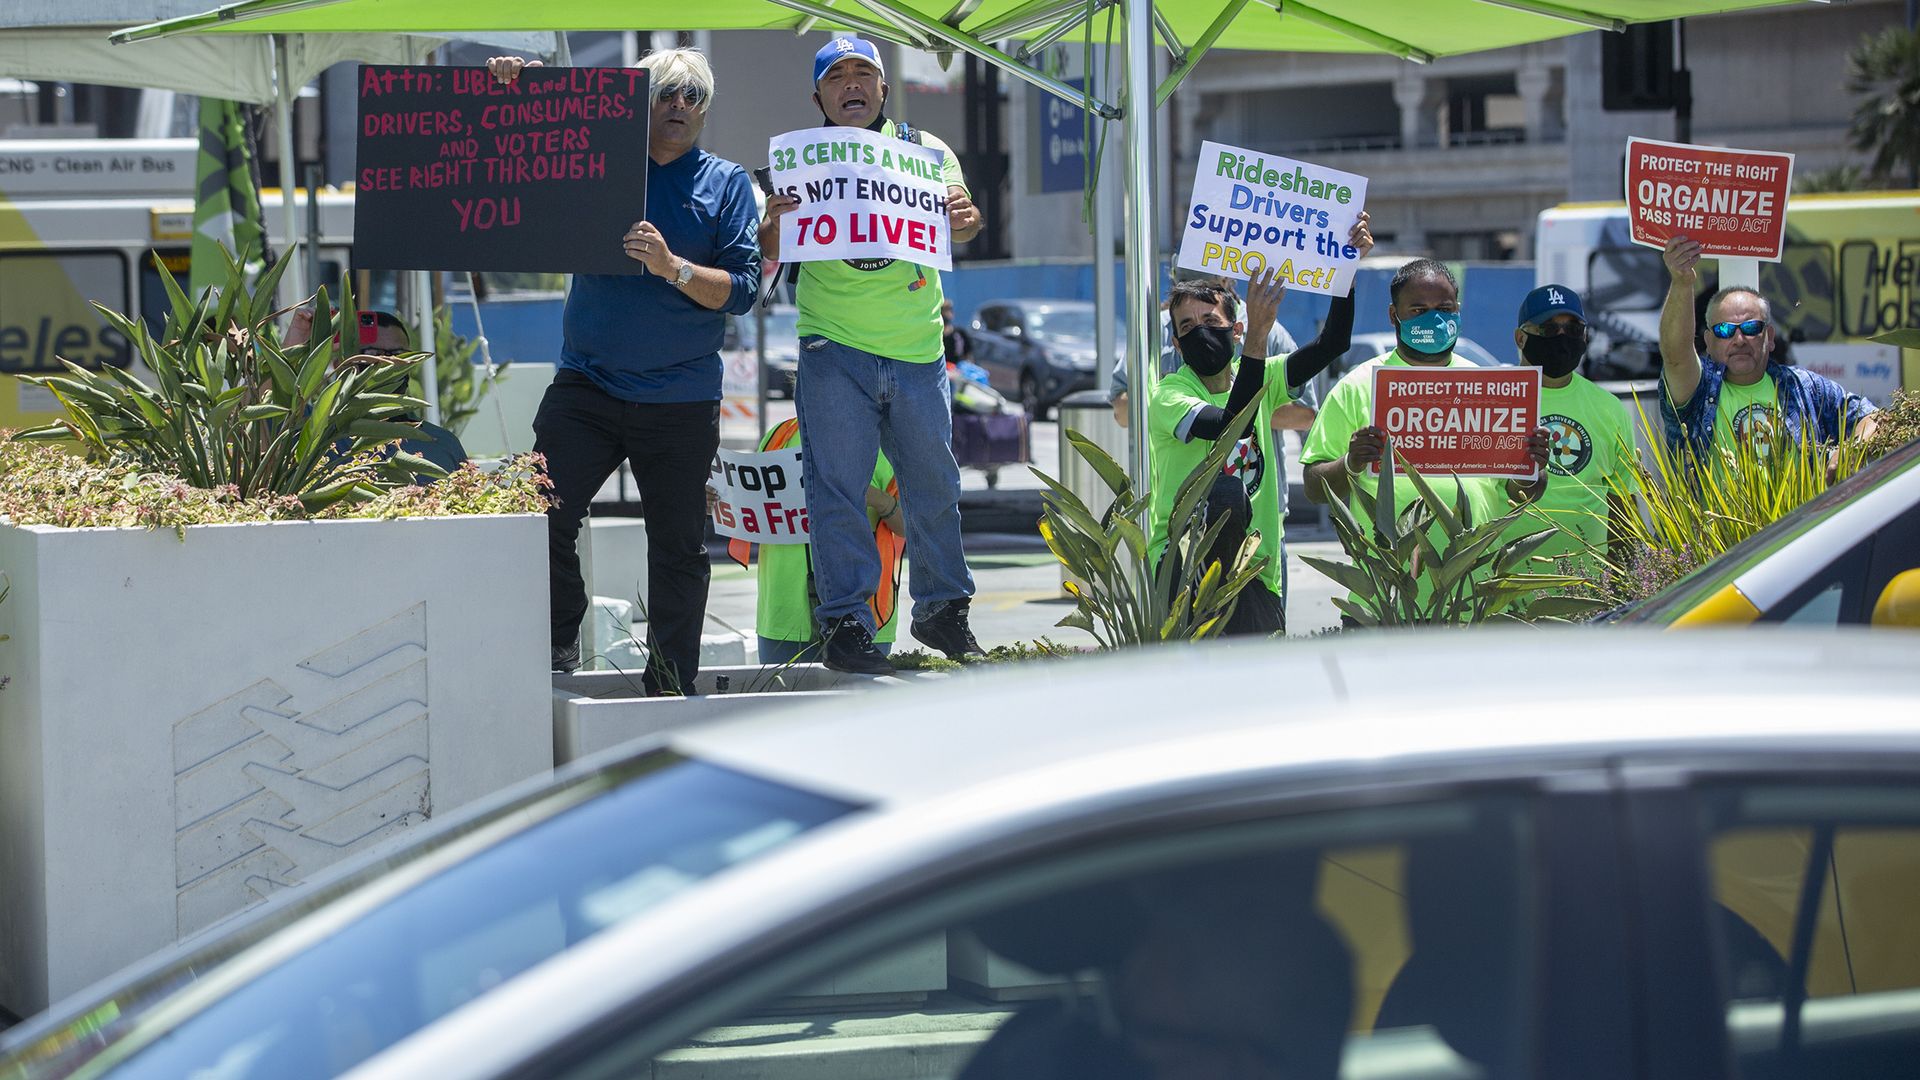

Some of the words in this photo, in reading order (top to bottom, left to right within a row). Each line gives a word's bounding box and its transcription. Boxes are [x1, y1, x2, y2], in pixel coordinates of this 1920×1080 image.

[362, 68, 442, 97] Attn:
[529, 76, 566, 94] and
[570, 68, 644, 96] LYFT
[364, 109, 473, 137] DRIVERS,
[481, 94, 634, 129] CONSUMERS,
[440, 138, 480, 159] AND
[495, 126, 591, 157] VOTERS
[0, 157, 35, 175] CNG
[54, 157, 103, 173] Clean
[110, 156, 136, 172] Air
[141, 155, 176, 173] Bus
[360, 168, 403, 191] SEE
[409, 159, 480, 189] RIGHT
[484, 153, 606, 184] THROUGH
[773, 147, 797, 172] 32
[803, 142, 875, 166] CENTS
[881, 149, 894, 168] A
[898, 153, 944, 184] MILE
[1216, 151, 1352, 205] Rideshare
[1640, 154, 1701, 174] PROTECT
[1705, 162, 1732, 177] THE
[1736, 165, 1779, 182] RIGHT
[805, 178, 849, 204] NOT
[857, 179, 947, 216] ENOUGH
[1701, 177, 1710, 185] to
[452, 197, 521, 232] YOU
[1229, 184, 1330, 228] Drivers
[1638, 180, 1774, 217] ORGANIZE
[797, 214, 837, 246] TO
[850, 213, 937, 254] LIVE!
[1190, 204, 1306, 251] Support
[1316, 231, 1358, 260] the
[1639, 207, 1672, 225] PASS
[1676, 213, 1704, 230] THE
[1707, 216, 1738, 232] PRO
[1741, 218, 1771, 234] ACT
[1201, 242, 1267, 277] PRO
[1272, 258, 1336, 290] Act!
[1547, 287, 1566, 305] LA
[1388, 381, 1452, 398] PROTECT
[1455, 382, 1483, 395] THE
[1487, 381, 1529, 397] RIGHT
[1453, 396, 1462, 405] to
[1387, 407, 1527, 433] ORGANIZE
[1550, 416, 1576, 427] DRIVERS
[1390, 435, 1425, 449] PASS
[1428, 436, 1457, 449] THE
[1461, 435, 1493, 449] PRO
[1495, 435, 1526, 449] ACT
[708, 453, 787, 498] Prop
[741, 507, 760, 533] a
